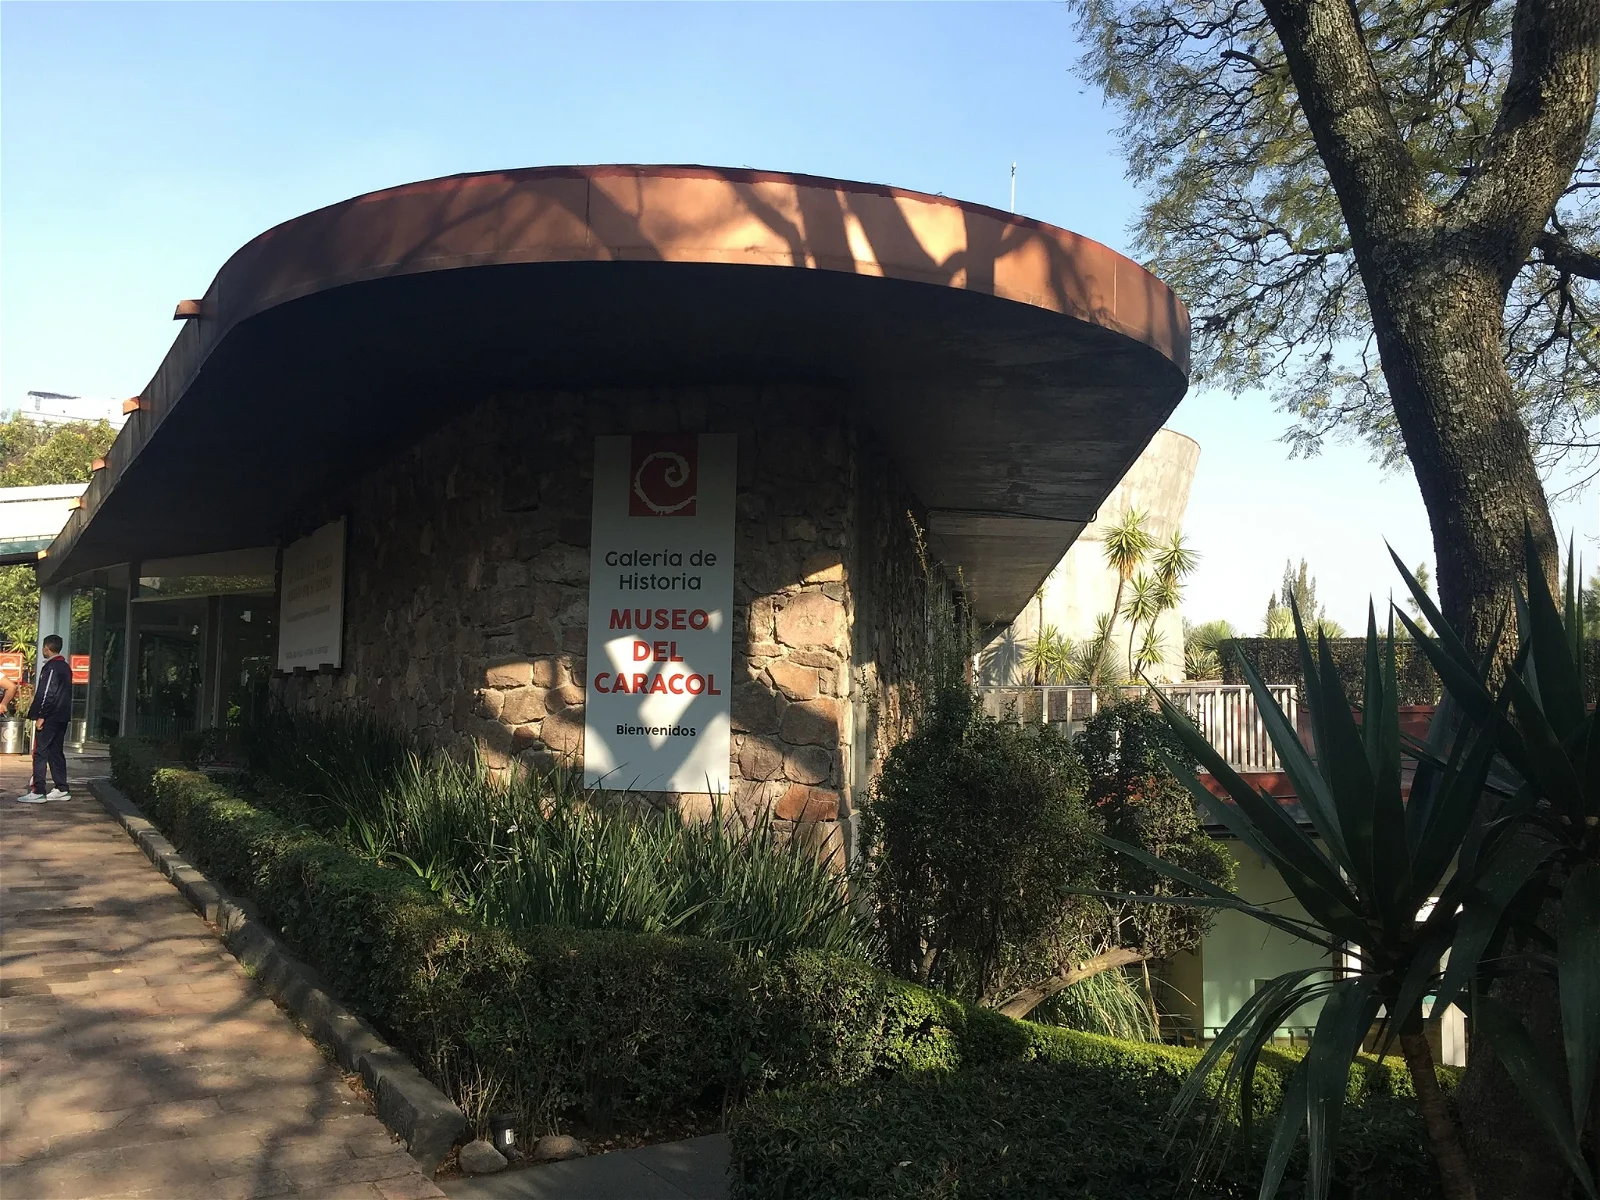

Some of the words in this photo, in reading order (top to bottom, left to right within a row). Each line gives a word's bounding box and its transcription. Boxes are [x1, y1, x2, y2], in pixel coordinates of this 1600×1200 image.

[605, 549, 683, 566] Galería
[689, 550, 717, 566] de
[620, 572, 701, 590] Historia
[610, 610, 708, 629] MUSEO
[634, 641, 684, 662] DEL
[595, 673, 721, 695] CARACOL
[616, 724, 697, 736] Bienvenidos
